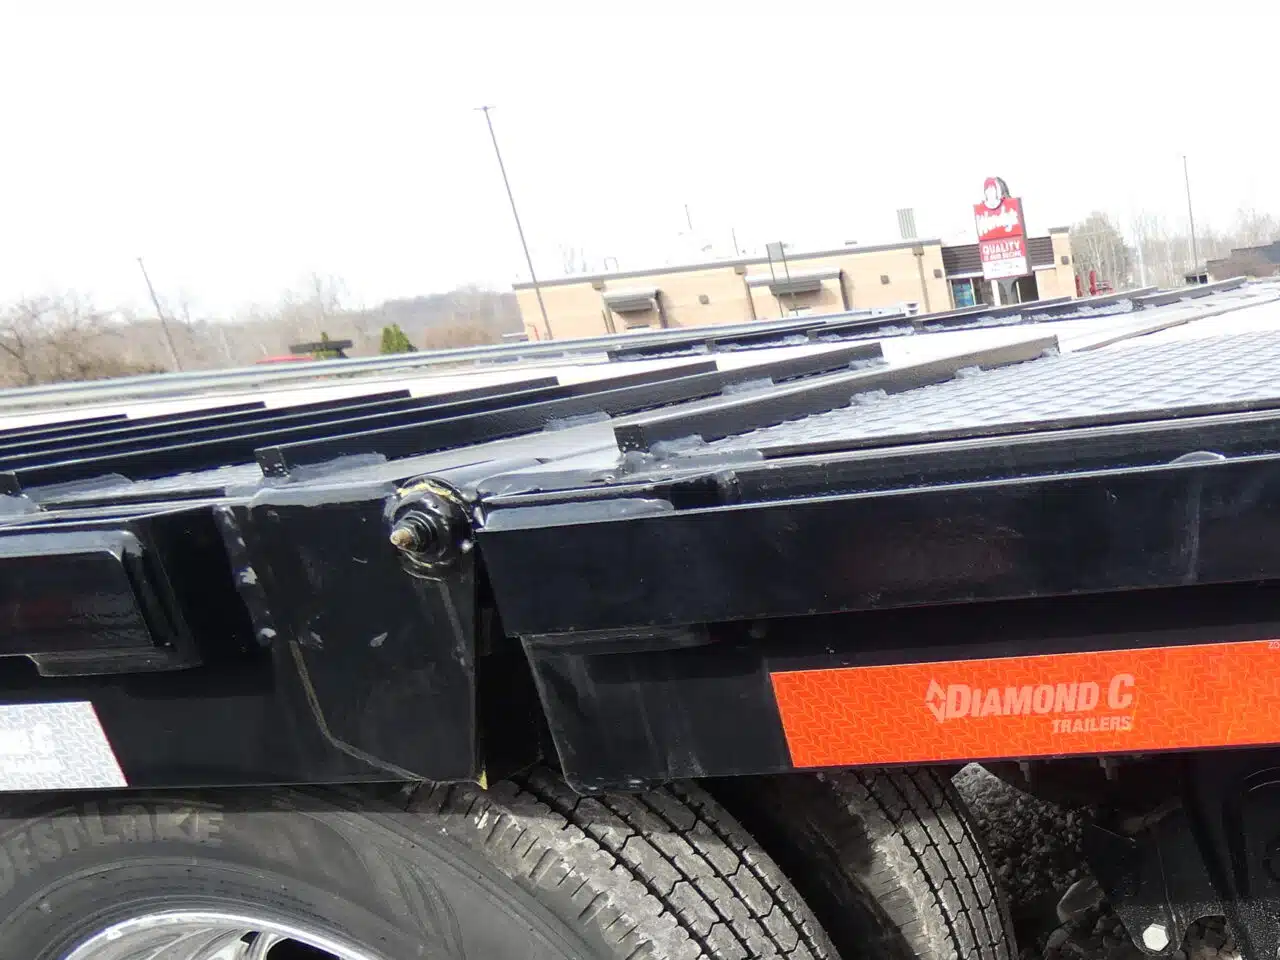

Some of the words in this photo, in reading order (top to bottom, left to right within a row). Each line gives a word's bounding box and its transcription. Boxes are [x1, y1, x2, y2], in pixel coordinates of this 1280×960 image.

[983, 240, 1020, 255] QUALITY
[944, 681, 1100, 720] DIAMOND
[1107, 673, 1136, 710] C
[1051, 715, 1133, 734] TRAILERS
